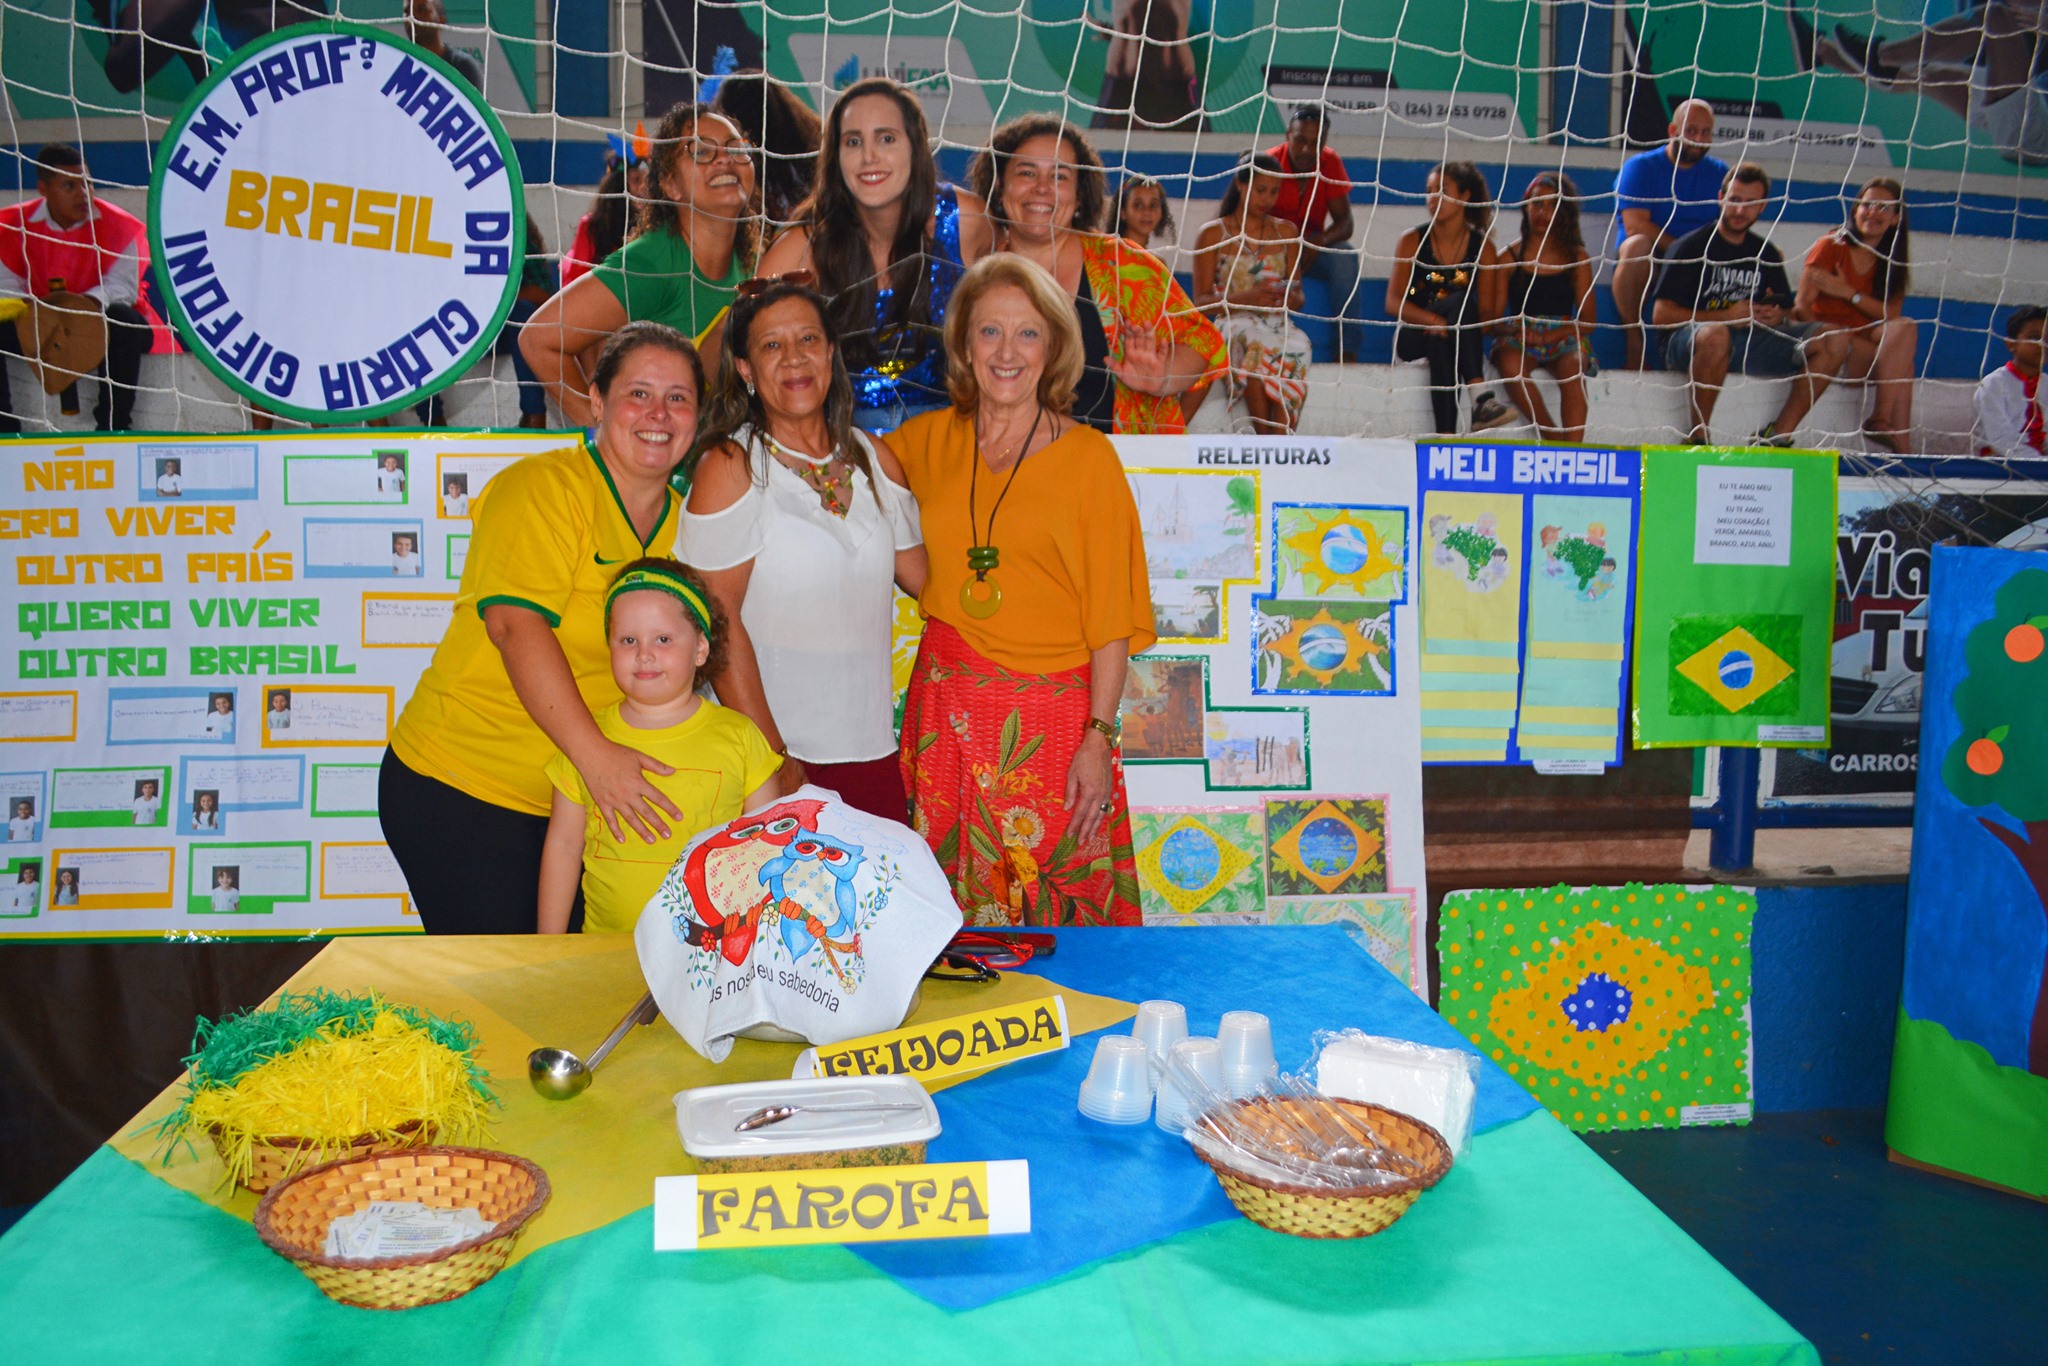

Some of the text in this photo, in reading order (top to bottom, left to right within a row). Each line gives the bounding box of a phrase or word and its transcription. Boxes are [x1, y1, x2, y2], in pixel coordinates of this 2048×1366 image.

[1282, 69, 1350, 84] Inscrev-se
[380, 54, 506, 191] MARIA
[1405, 102, 1433, 117] (24)
[1473, 106, 1507, 119] 0728
[167, 104, 243, 192] E.M.
[224, 168, 454, 259] BRASIL
[464, 210, 511, 275] DA
[163, 229, 300, 398] GIFFONI
[318, 298, 481, 411] GLÓRIA
[23, 446, 115, 492] NÃO
[1197, 446, 1332, 466] RELEITURAS
[1429, 446, 1630, 486] MEU BRASIL
[1739, 483, 1756, 491] AMO
[1757, 484, 1772, 492] MEU
[105, 505, 236, 537] VIVER
[1716, 517, 1733, 525] MEU
[1733, 516, 1766, 526] CORAÇÃO
[16, 529, 294, 585] OUTRO PAÍS
[1836, 529, 1932, 602] Via
[18, 598, 320, 641] QUERO VIVER
[18, 644, 357, 679] OUTRO BRASIL
[727, 973, 752, 996] nos
[778, 969, 841, 1014] sabedoria
[819, 1005, 1063, 1078] FEIJOADA
[697, 1174, 990, 1239] FAROFA
